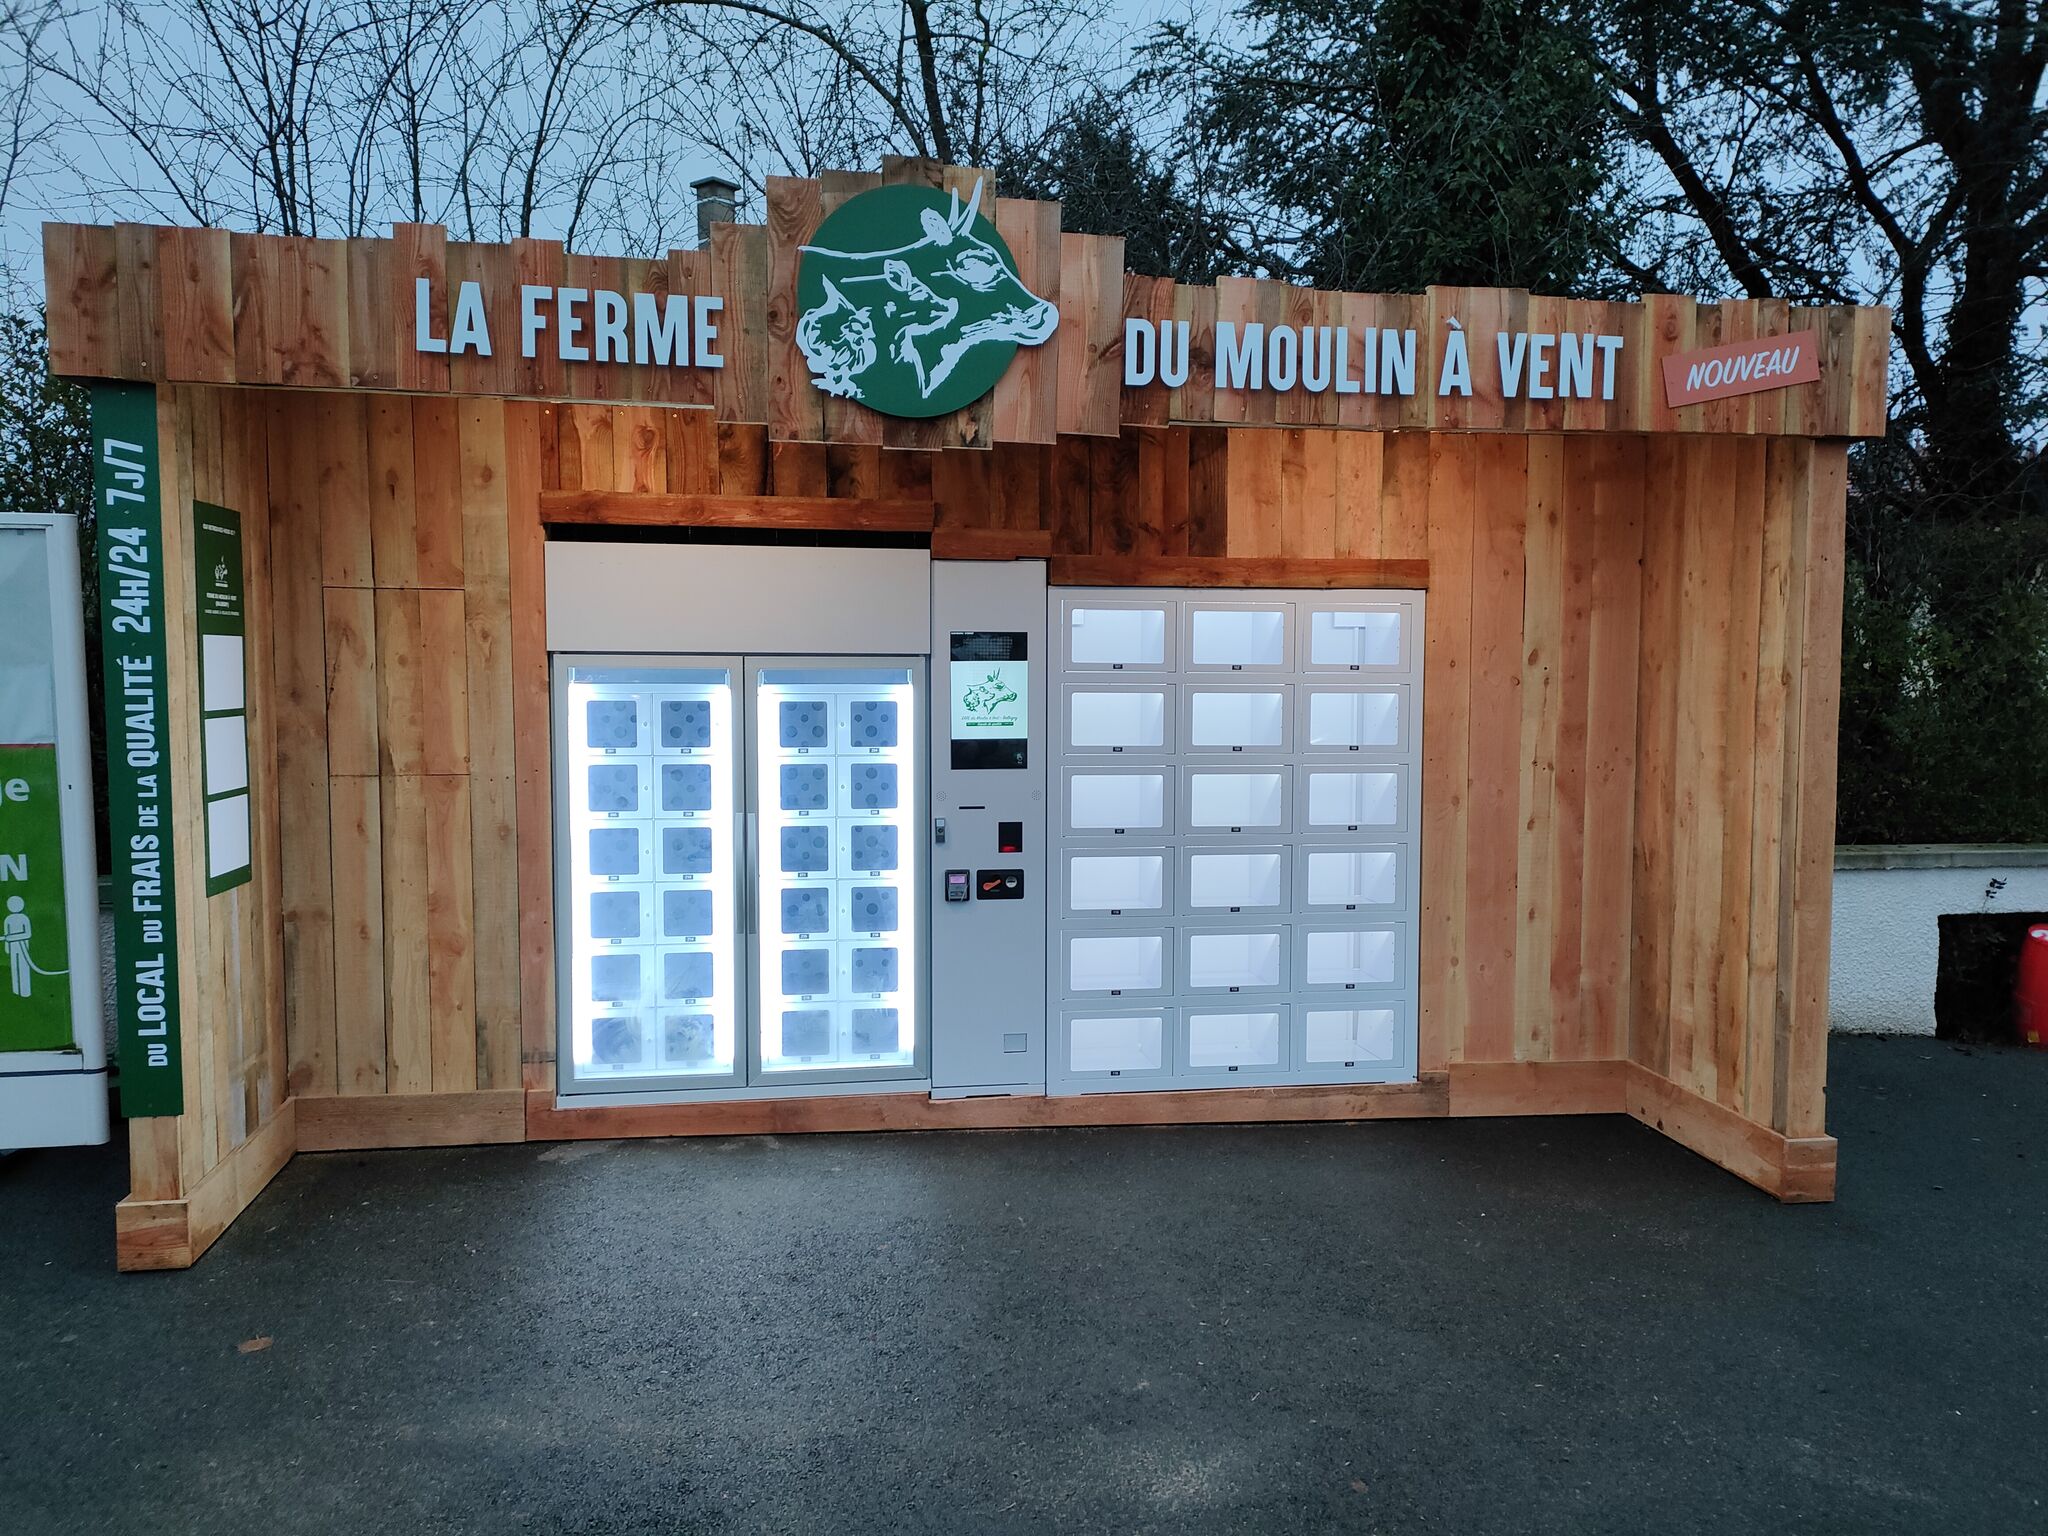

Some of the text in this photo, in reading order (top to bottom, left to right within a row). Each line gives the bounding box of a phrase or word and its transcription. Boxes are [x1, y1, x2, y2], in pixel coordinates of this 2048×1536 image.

[415, 278, 1624, 400] LA FERME DU MOULIN À VENT
[1686, 345, 1800, 392] NOUVEAU
[103, 438, 168, 1067] DU LOCAL DU FRAIS DE LA QUALITÉ 24H/24 7J/7
